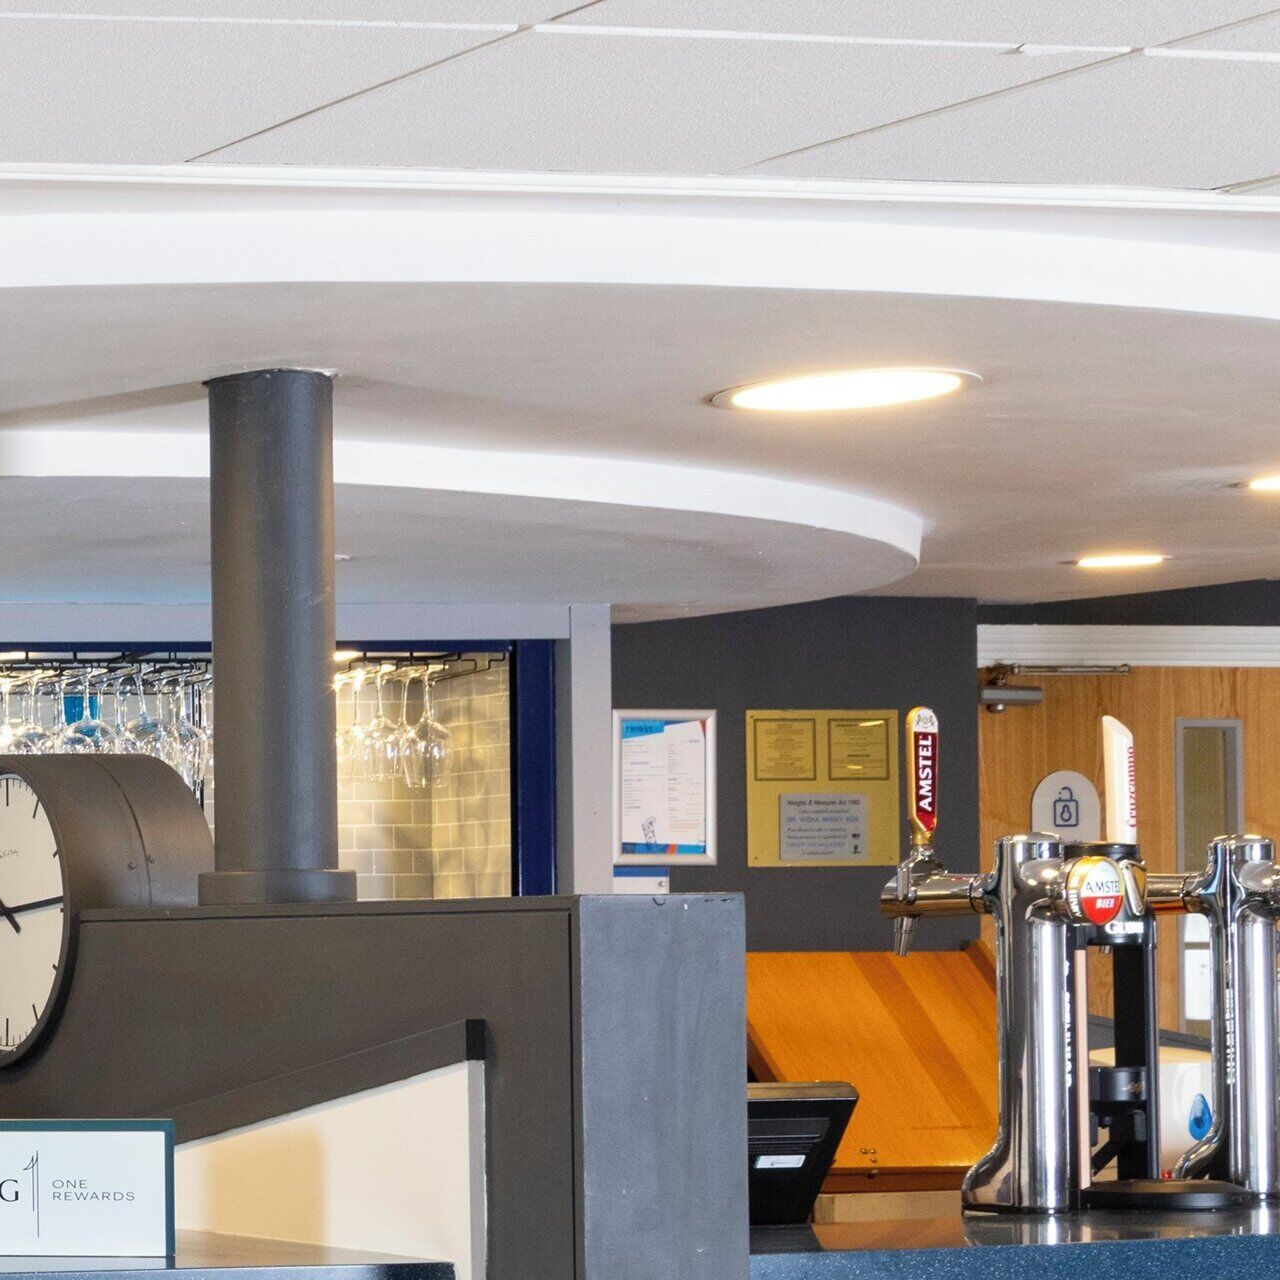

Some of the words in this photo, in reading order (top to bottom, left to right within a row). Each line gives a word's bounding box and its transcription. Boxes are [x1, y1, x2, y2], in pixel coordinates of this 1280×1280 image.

[919, 735, 932, 811] AMSTEL
[1096, 899, 1115, 909] BIER
[52, 1179, 88, 1189] ONE
[52, 1192, 135, 1201] REWARDS
